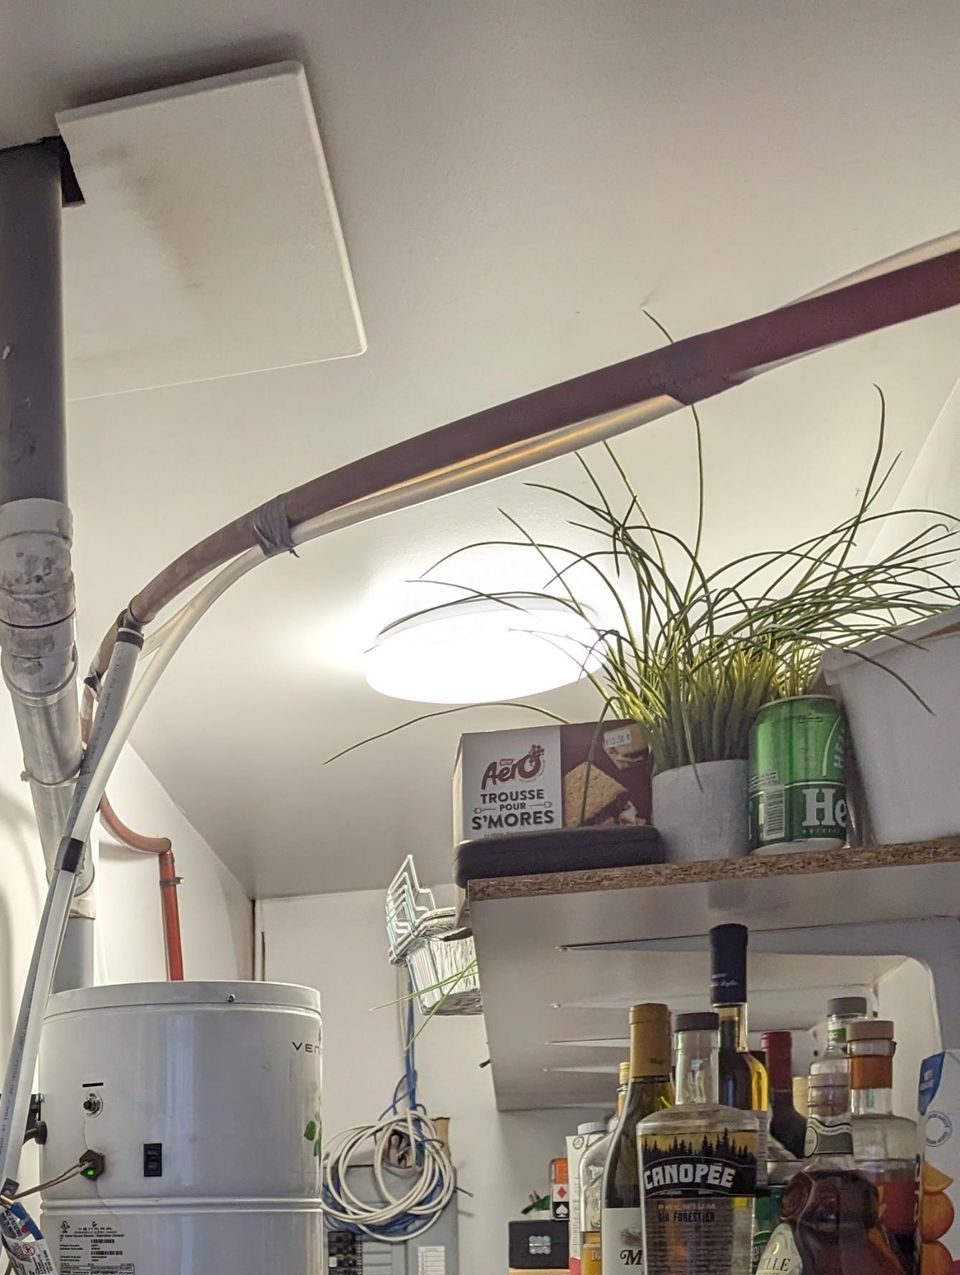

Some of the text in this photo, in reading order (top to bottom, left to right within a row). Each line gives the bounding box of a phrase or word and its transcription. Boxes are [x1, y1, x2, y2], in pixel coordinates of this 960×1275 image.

[480, 789, 544, 804] TROUSSE
[499, 801, 527, 811] POUR
[471, 809, 554, 831] S'MORES
[643, 1162, 736, 1190] CANOPÉE
